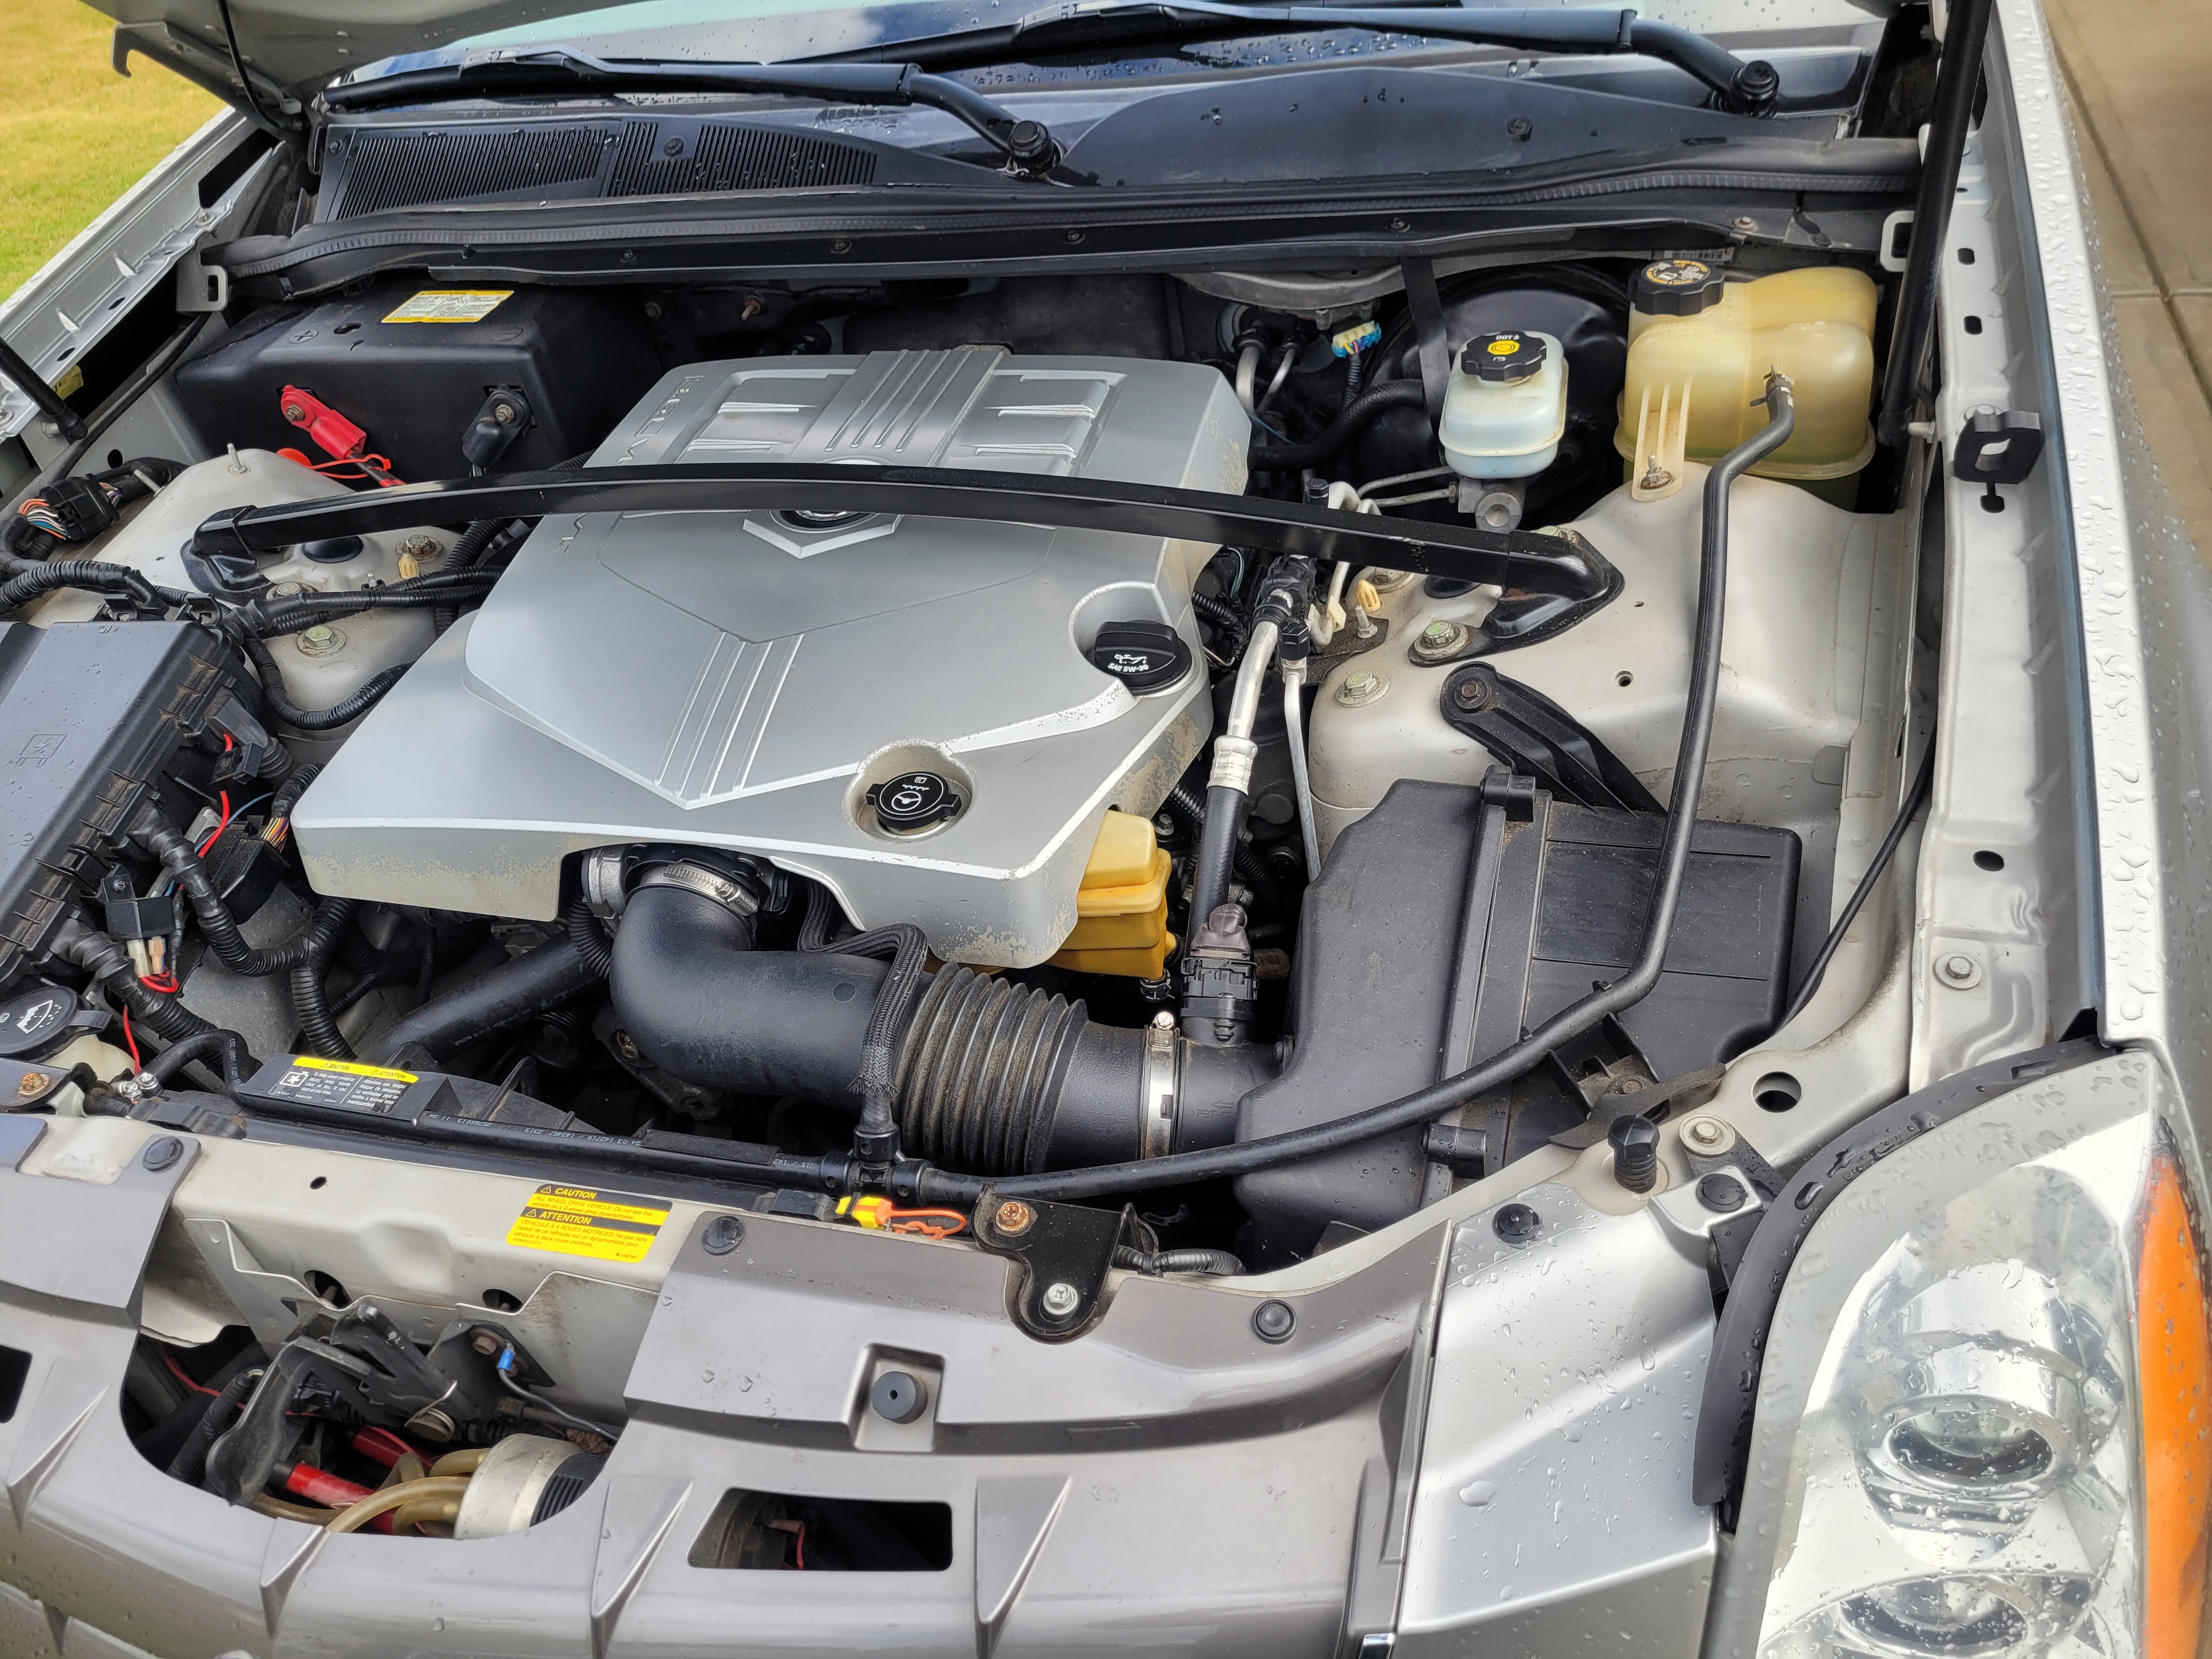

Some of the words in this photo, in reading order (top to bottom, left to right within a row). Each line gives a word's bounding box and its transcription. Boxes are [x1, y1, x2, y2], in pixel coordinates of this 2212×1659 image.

[1108, 663, 1122, 672] SAE
[1123, 664, 1149, 673] 5W-30
[378, 1070, 406, 1079] ATTENTION
[587, 1135, 614, 1143] 142719
[555, 1188, 596, 1199] CAUTION
[540, 1211, 591, 1224] ATTENTION
[598, 1211, 634, 1222] dynamometer.
[521, 1220, 550, 1228] VÉHICULE
[582, 1228, 613, 1237] MOTRICES:
